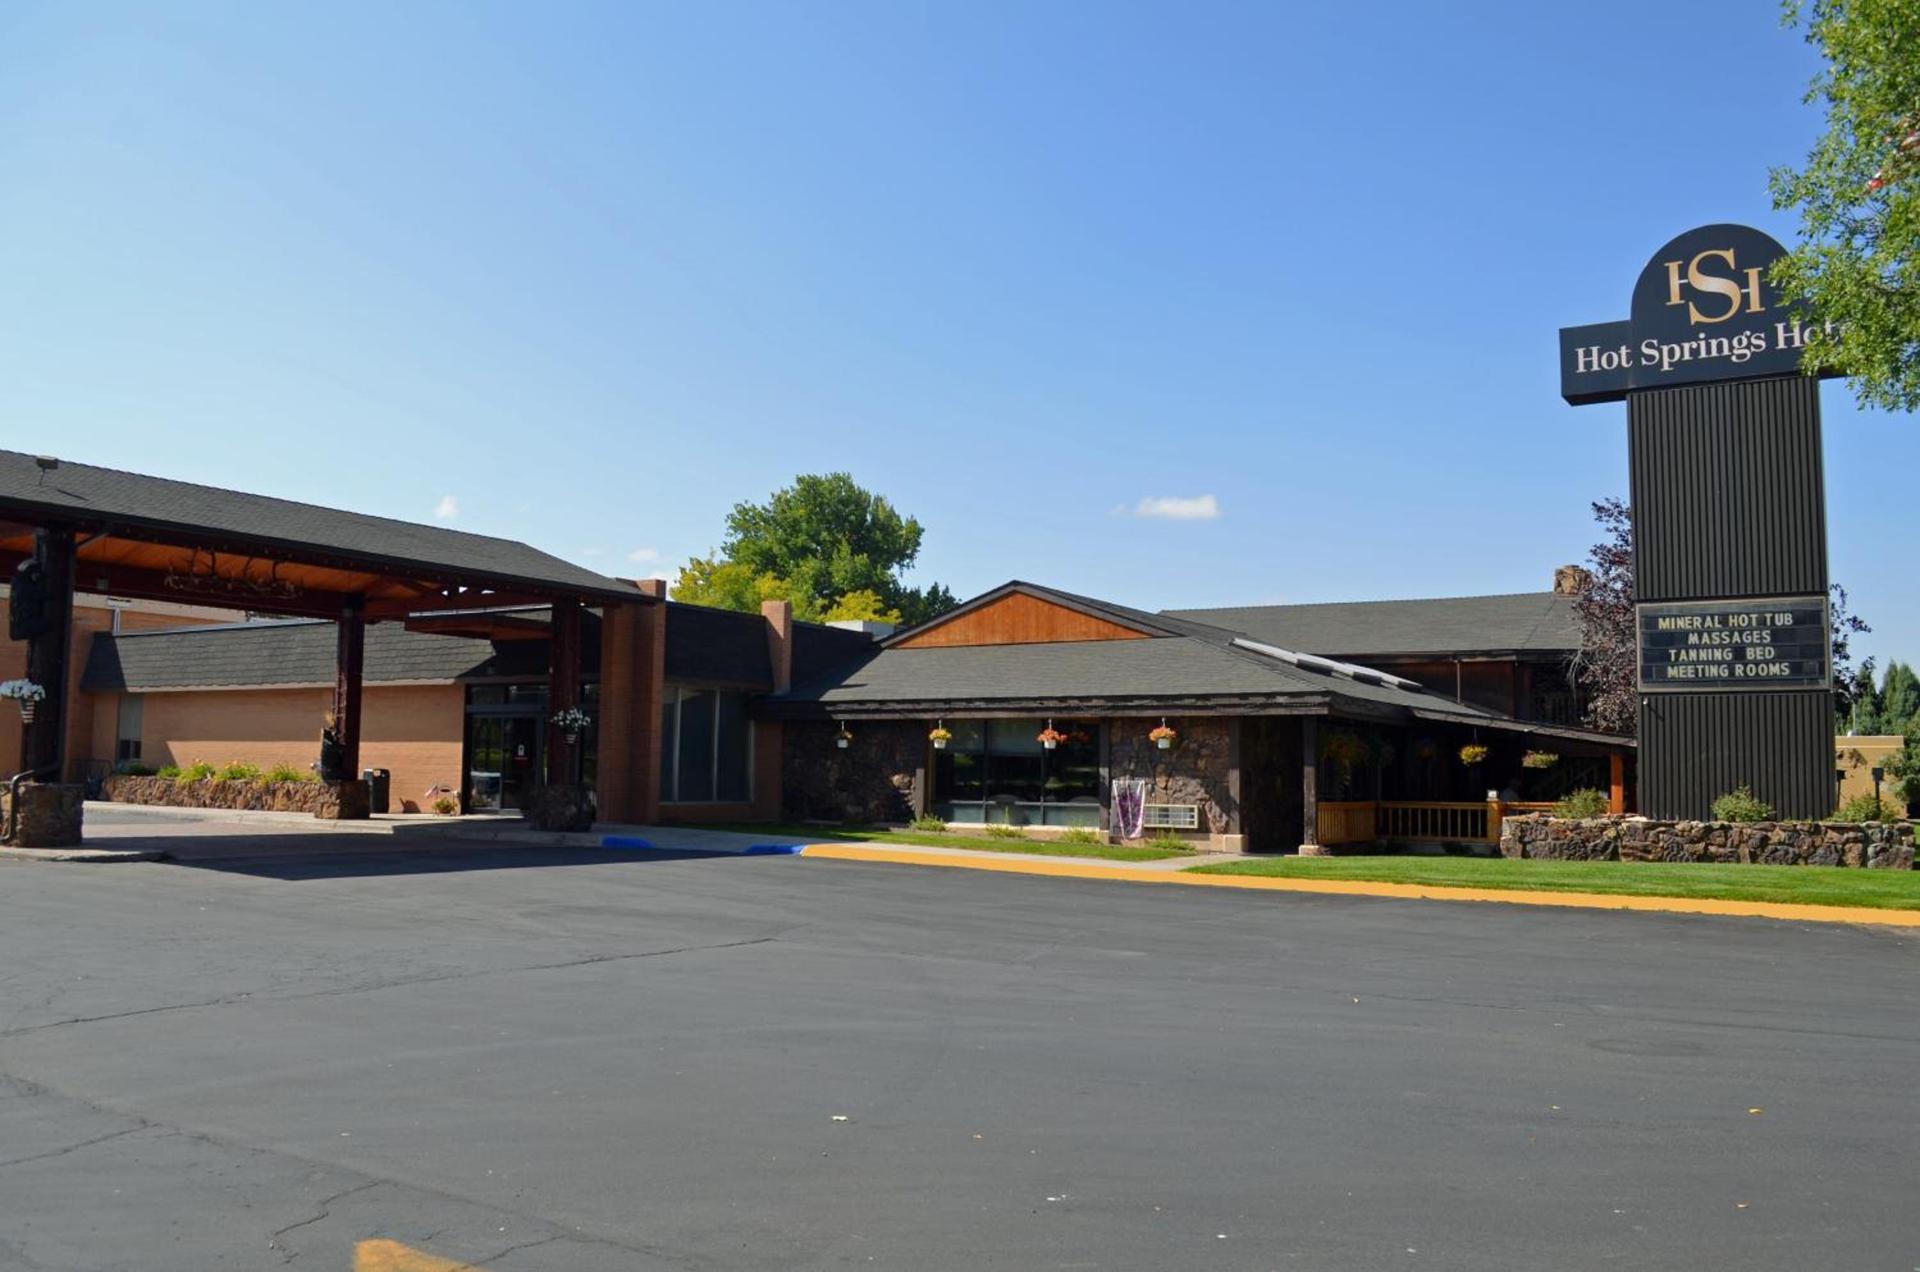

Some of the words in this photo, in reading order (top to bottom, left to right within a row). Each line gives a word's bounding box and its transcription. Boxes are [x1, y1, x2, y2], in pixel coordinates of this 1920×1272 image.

[1575, 345, 1633, 373] Hot
[1640, 332, 1766, 371] Springs
[1774, 317, 1850, 350] Hot
[1658, 616, 1723, 630] MINERAL
[1729, 614, 1758, 627] HOT
[1765, 613, 1794, 627] TUB
[1688, 630, 1771, 645] MASSAGES
[1669, 647, 1733, 662] TANNING
[1746, 647, 1775, 660] BED
[1667, 664, 1729, 678] MEETING
[1735, 662, 1791, 677] ROOMS
